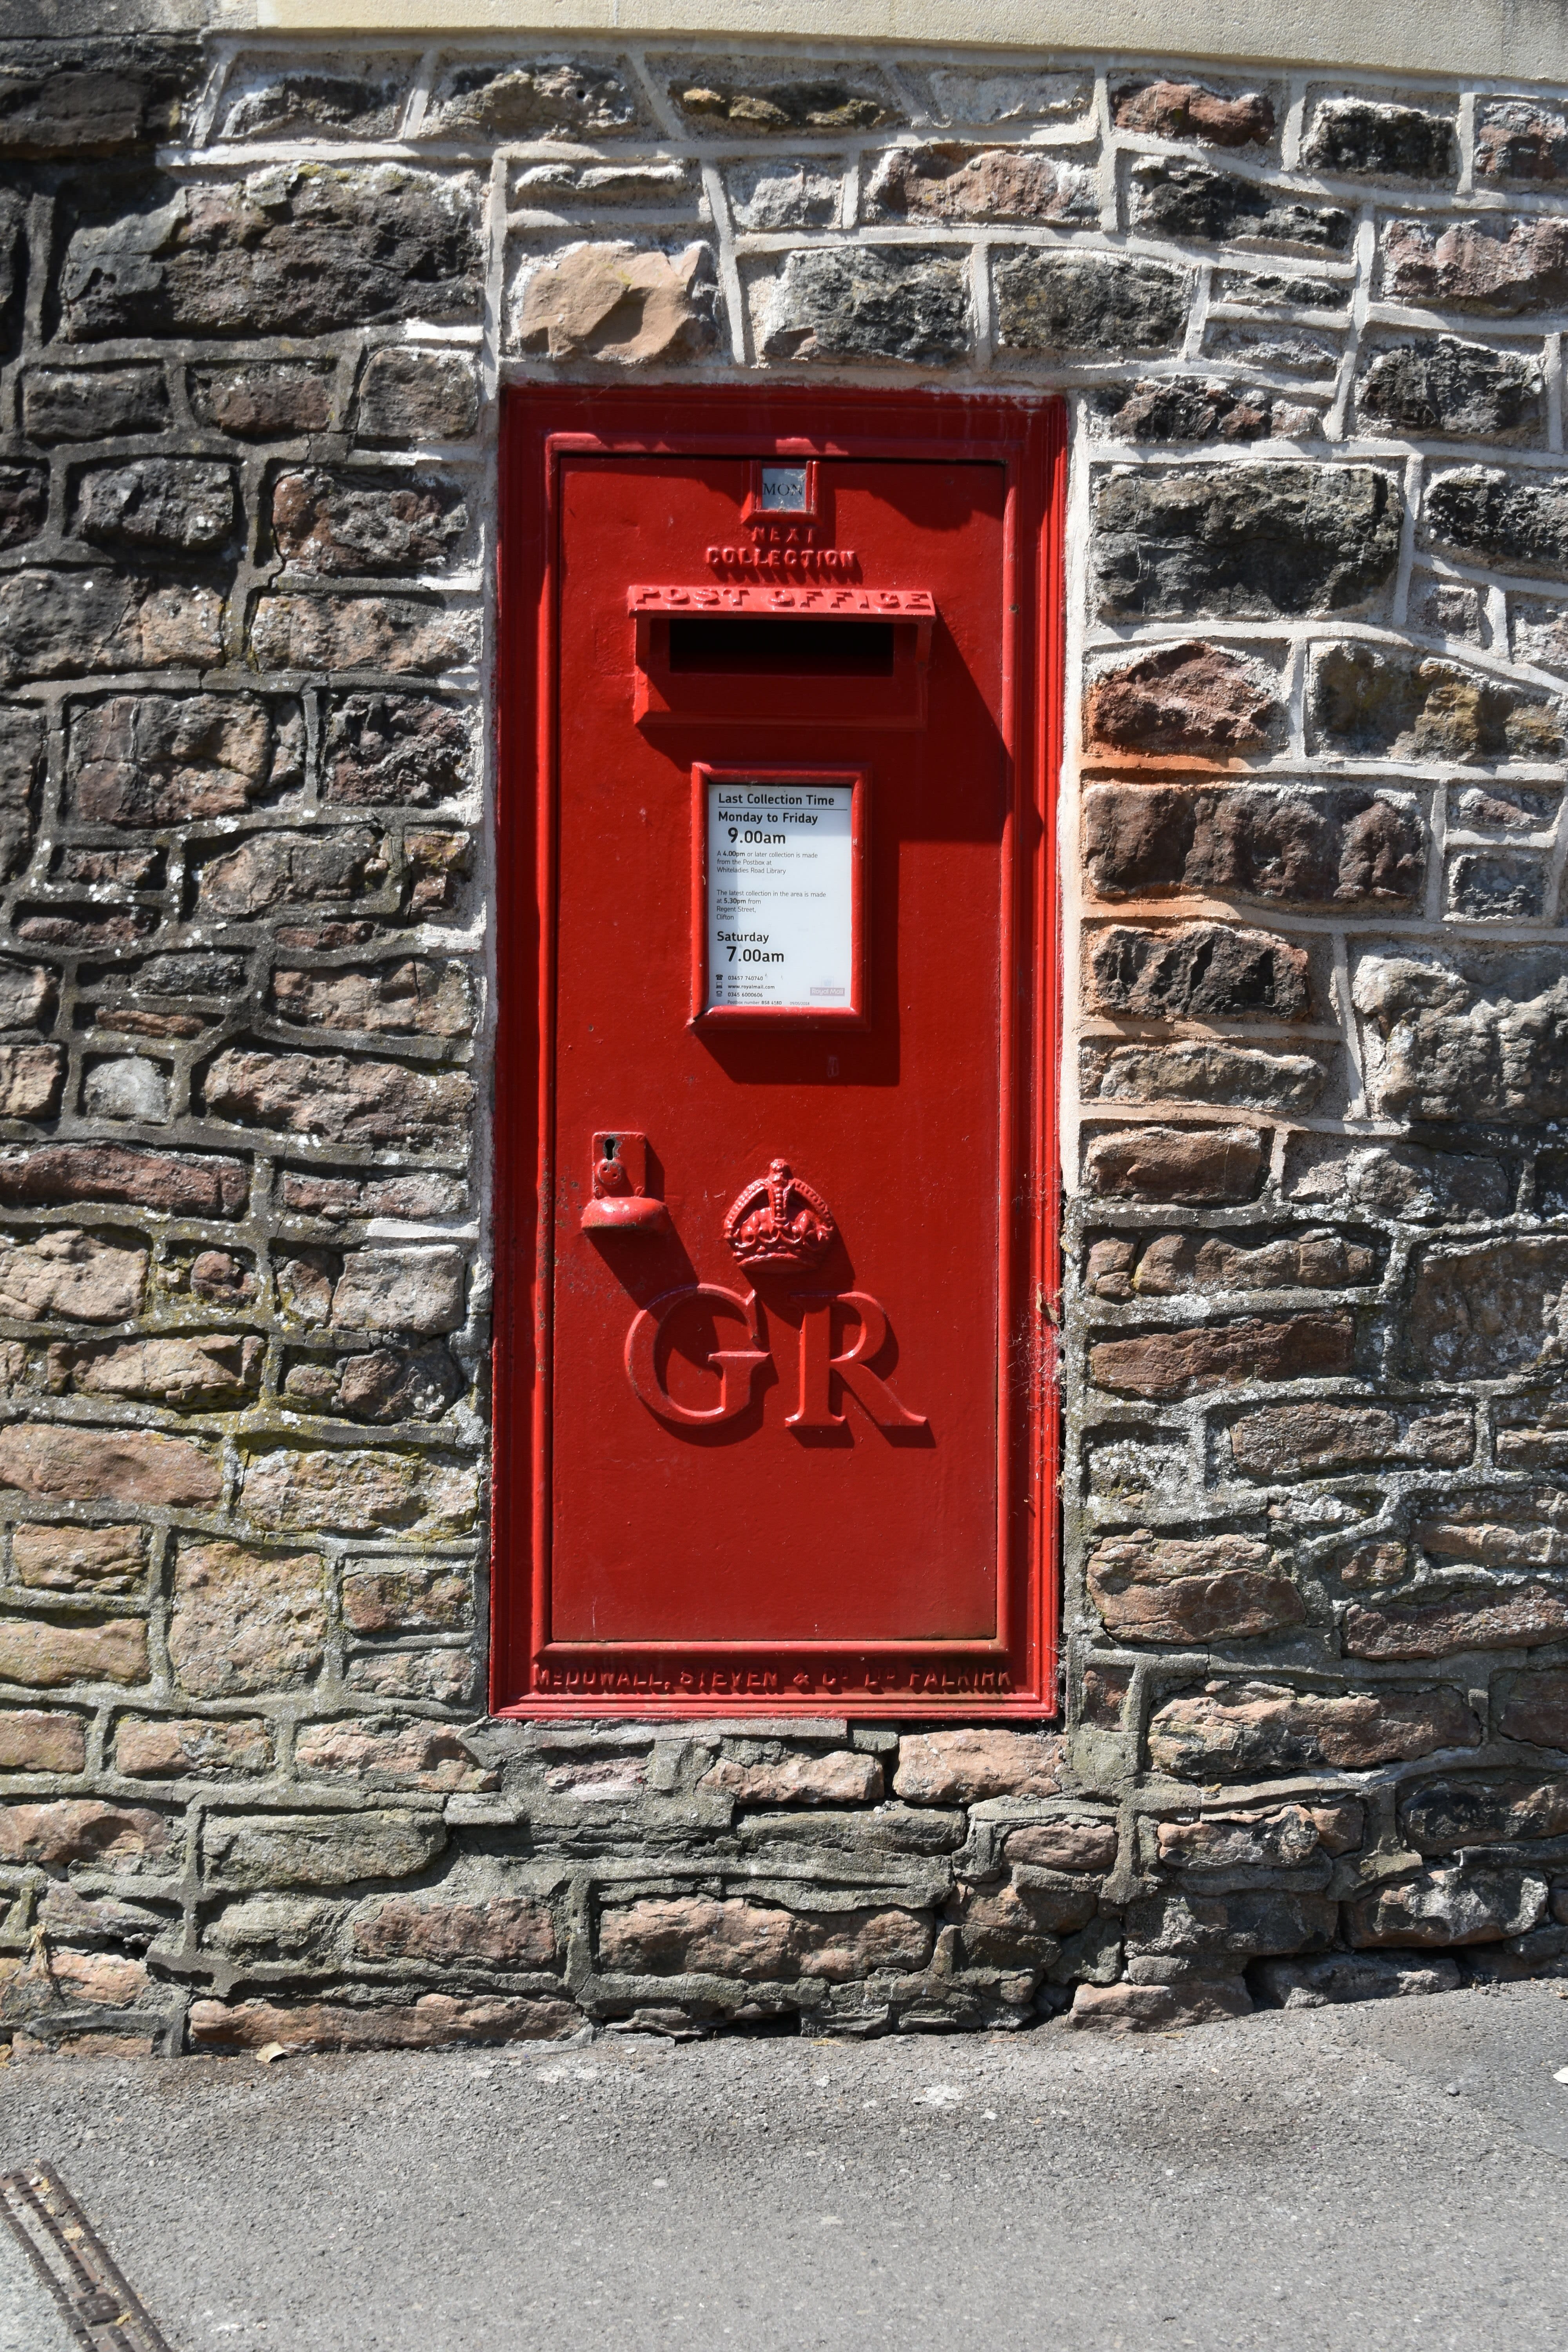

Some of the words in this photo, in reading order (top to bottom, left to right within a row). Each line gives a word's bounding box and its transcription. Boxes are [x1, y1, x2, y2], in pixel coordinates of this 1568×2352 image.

[763, 483, 803, 496] MON
[752, 526, 814, 543] NEXT
[705, 547, 855, 568] COLLECTION
[636, 588, 750, 607] POST
[767, 590, 932, 611] OFFICE
[718, 793, 743, 804] Last
[747, 793, 802, 805] Collection
[806, 795, 834, 805] Time
[718, 811, 762, 824] Monday
[767, 813, 778, 823] to
[783, 813, 818, 825] Friday
[728, 827, 786, 844] 9.00am
[717, 931, 769, 944] Saturday
[726, 946, 784, 962] 7.00am
[624, 1283, 927, 1426] GR
[681, 1666, 778, 1688] STEVEN
[793, 1666, 809, 1686] &
[909, 1665, 1013, 1687] FALKIRK
